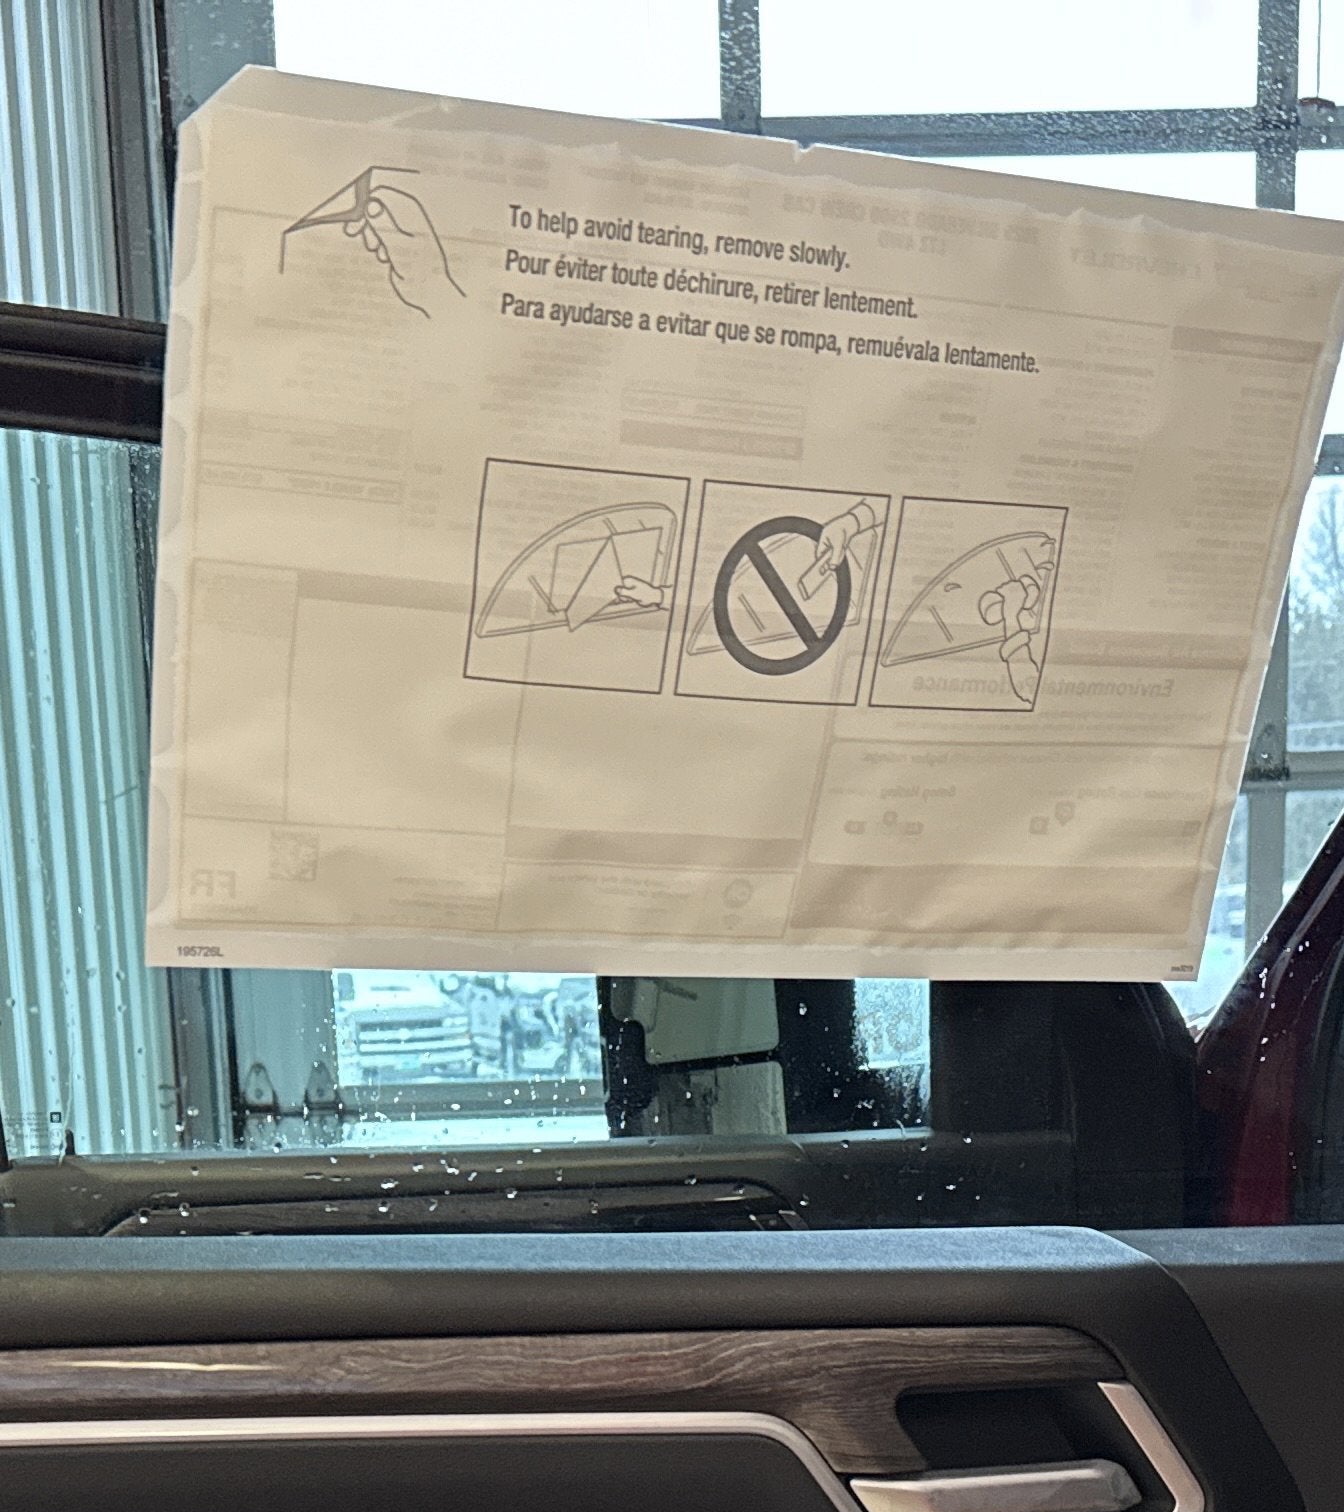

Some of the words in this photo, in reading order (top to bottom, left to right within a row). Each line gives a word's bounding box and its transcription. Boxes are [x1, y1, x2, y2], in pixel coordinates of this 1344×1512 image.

[508, 204, 532, 230] To
[537, 208, 579, 239] help
[583, 217, 633, 242] avoid
[637, 221, 709, 256] tearing,
[714, 235, 785, 261] remove
[789, 240, 850, 273] slowly.
[505, 248, 551, 276] Pour
[554, 253, 608, 282] éviter
[611, 262, 658, 289] toute
[663, 268, 759, 304] déchirure,
[764, 282, 820, 307] retirer
[823, 286, 918, 319] lentement.
[500, 292, 545, 320] Para
[549, 302, 633, 329] ayudarse
[638, 313, 651, 331] a
[656, 312, 712, 337] evitar
[715, 321, 750, 345] que
[754, 325, 776, 345] se
[780, 329, 842, 356] rompa,
[847, 335, 940, 363] remuévala
[944, 342, 1040, 374] lentamente.
